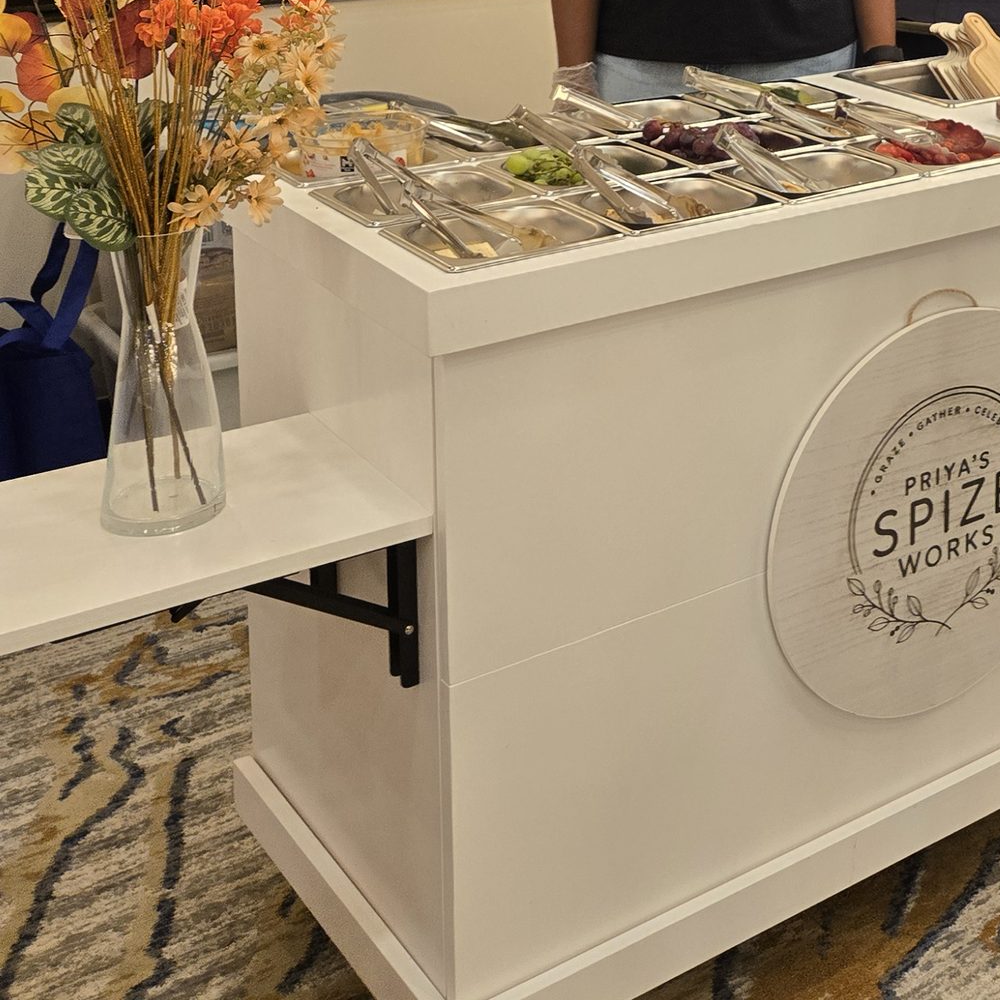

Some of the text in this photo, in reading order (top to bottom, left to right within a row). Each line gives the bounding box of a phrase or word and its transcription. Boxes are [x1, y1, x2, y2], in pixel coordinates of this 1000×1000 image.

[874, 438, 906, 484] GRAZE
[916, 405, 962, 431] GATHER
[904, 451, 990, 497] PRIYA'S
[897, 524, 994, 578] WORKS
